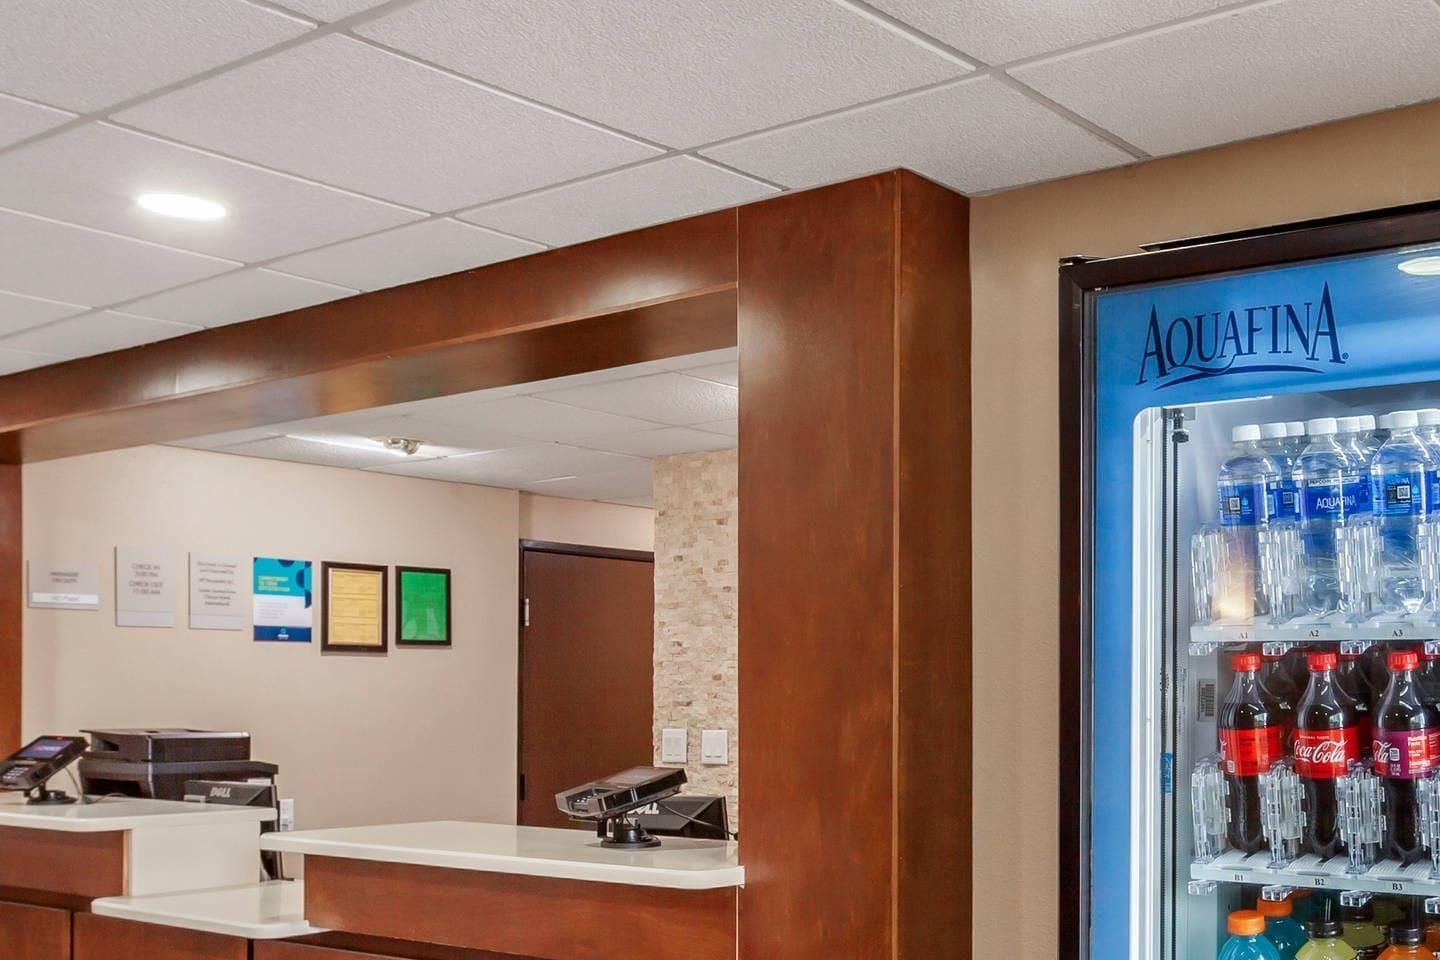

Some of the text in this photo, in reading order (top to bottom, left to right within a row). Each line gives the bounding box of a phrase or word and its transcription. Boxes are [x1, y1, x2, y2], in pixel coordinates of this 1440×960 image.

[1136, 280, 1346, 386] AQUAFINA
[1308, 630, 1320, 638] A2
[1392, 630, 1403, 638] A3
[1294, 740, 1348, 764] Coca-Cola
[210, 787, 231, 798] DELL
[1314, 878, 1325, 886] B2
[1392, 882, 1403, 890] B3
